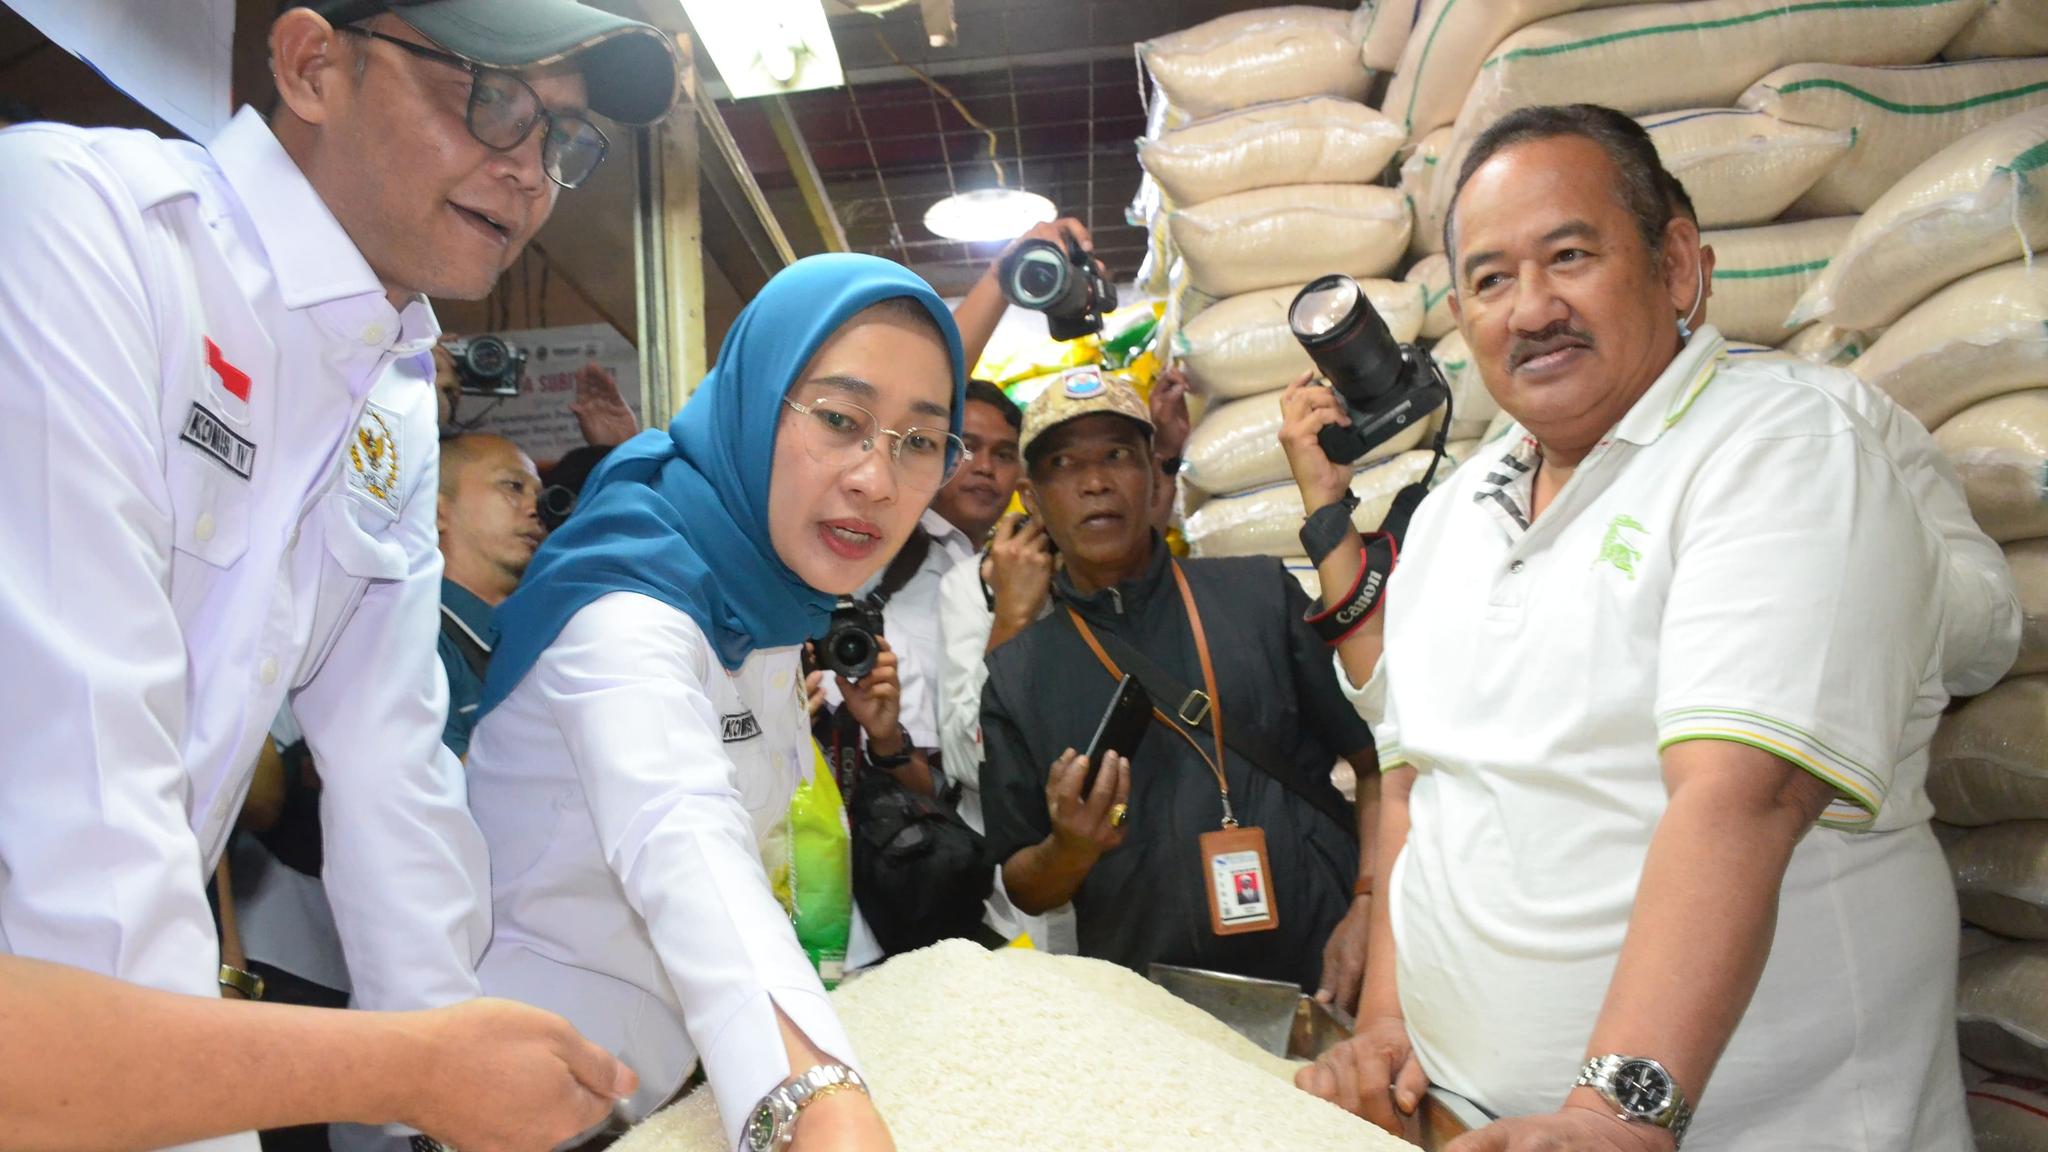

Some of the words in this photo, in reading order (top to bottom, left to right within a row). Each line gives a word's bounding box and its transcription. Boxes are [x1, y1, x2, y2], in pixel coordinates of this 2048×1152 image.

[189, 409, 232, 462] KOMISI
[235, 442, 250, 470] IV
[1336, 570, 1382, 624] Canon
